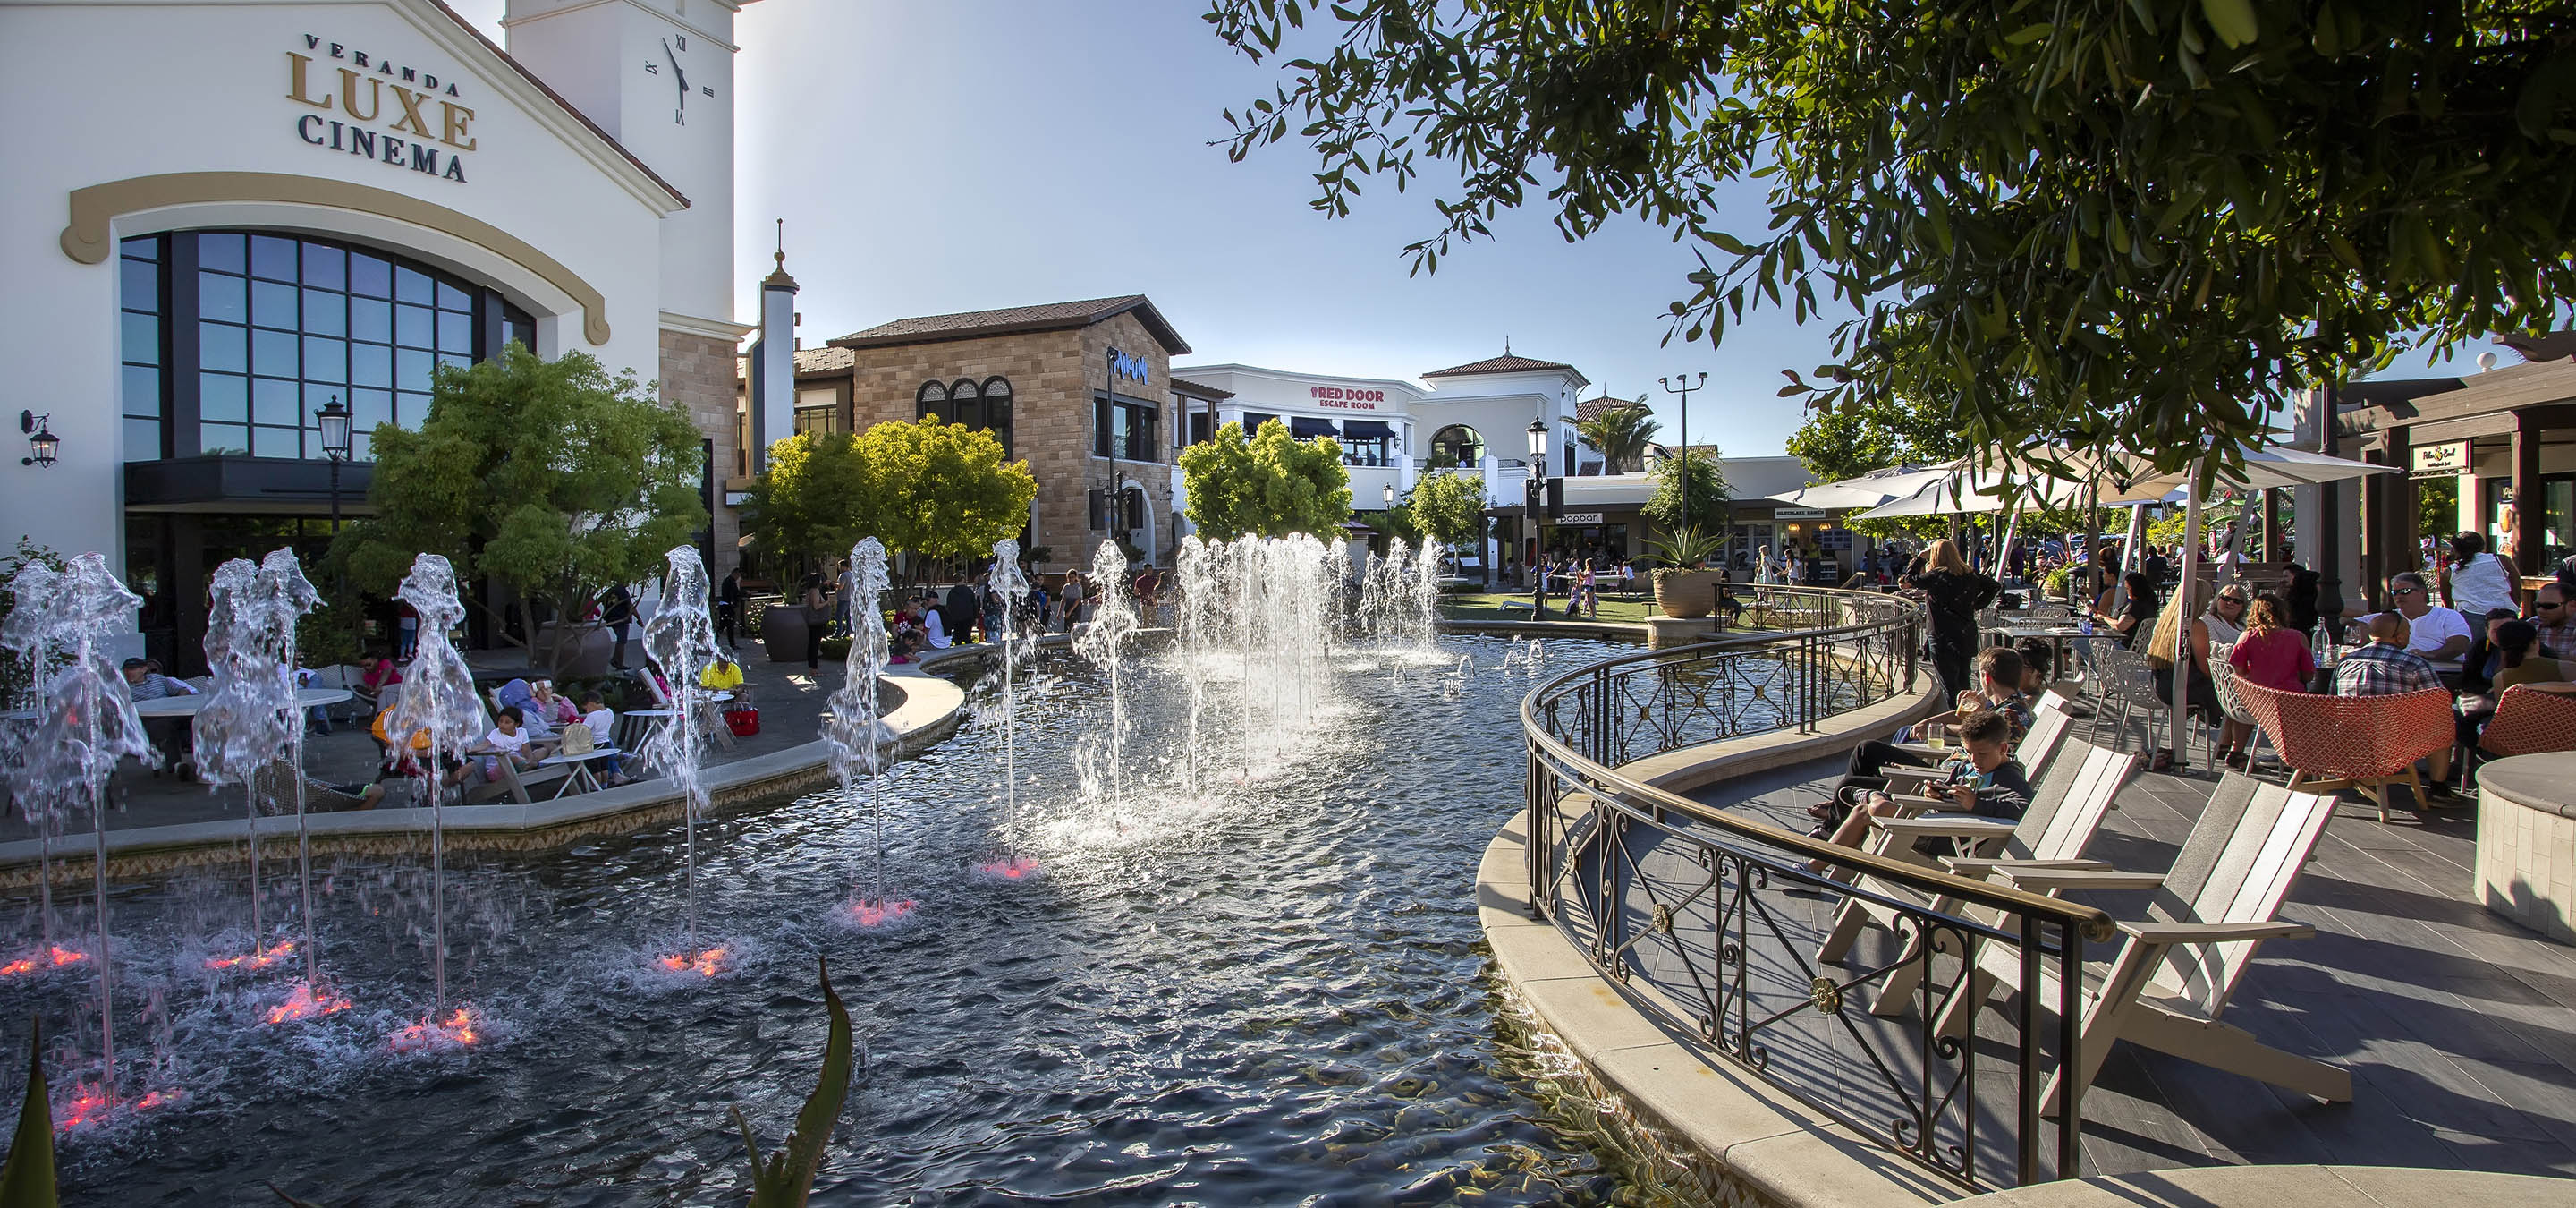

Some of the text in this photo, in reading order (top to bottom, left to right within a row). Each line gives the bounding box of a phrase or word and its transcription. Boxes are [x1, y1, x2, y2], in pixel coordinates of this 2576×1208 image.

[304, 33, 460, 97] VERANDA
[285, 51, 477, 151] LUXE
[298, 114, 468, 183] CINEMA
[1318, 387, 1385, 403] RED DOOR
[1319, 399, 1375, 410] ESCAPE ROOM
[1560, 514, 1598, 523] popbar
